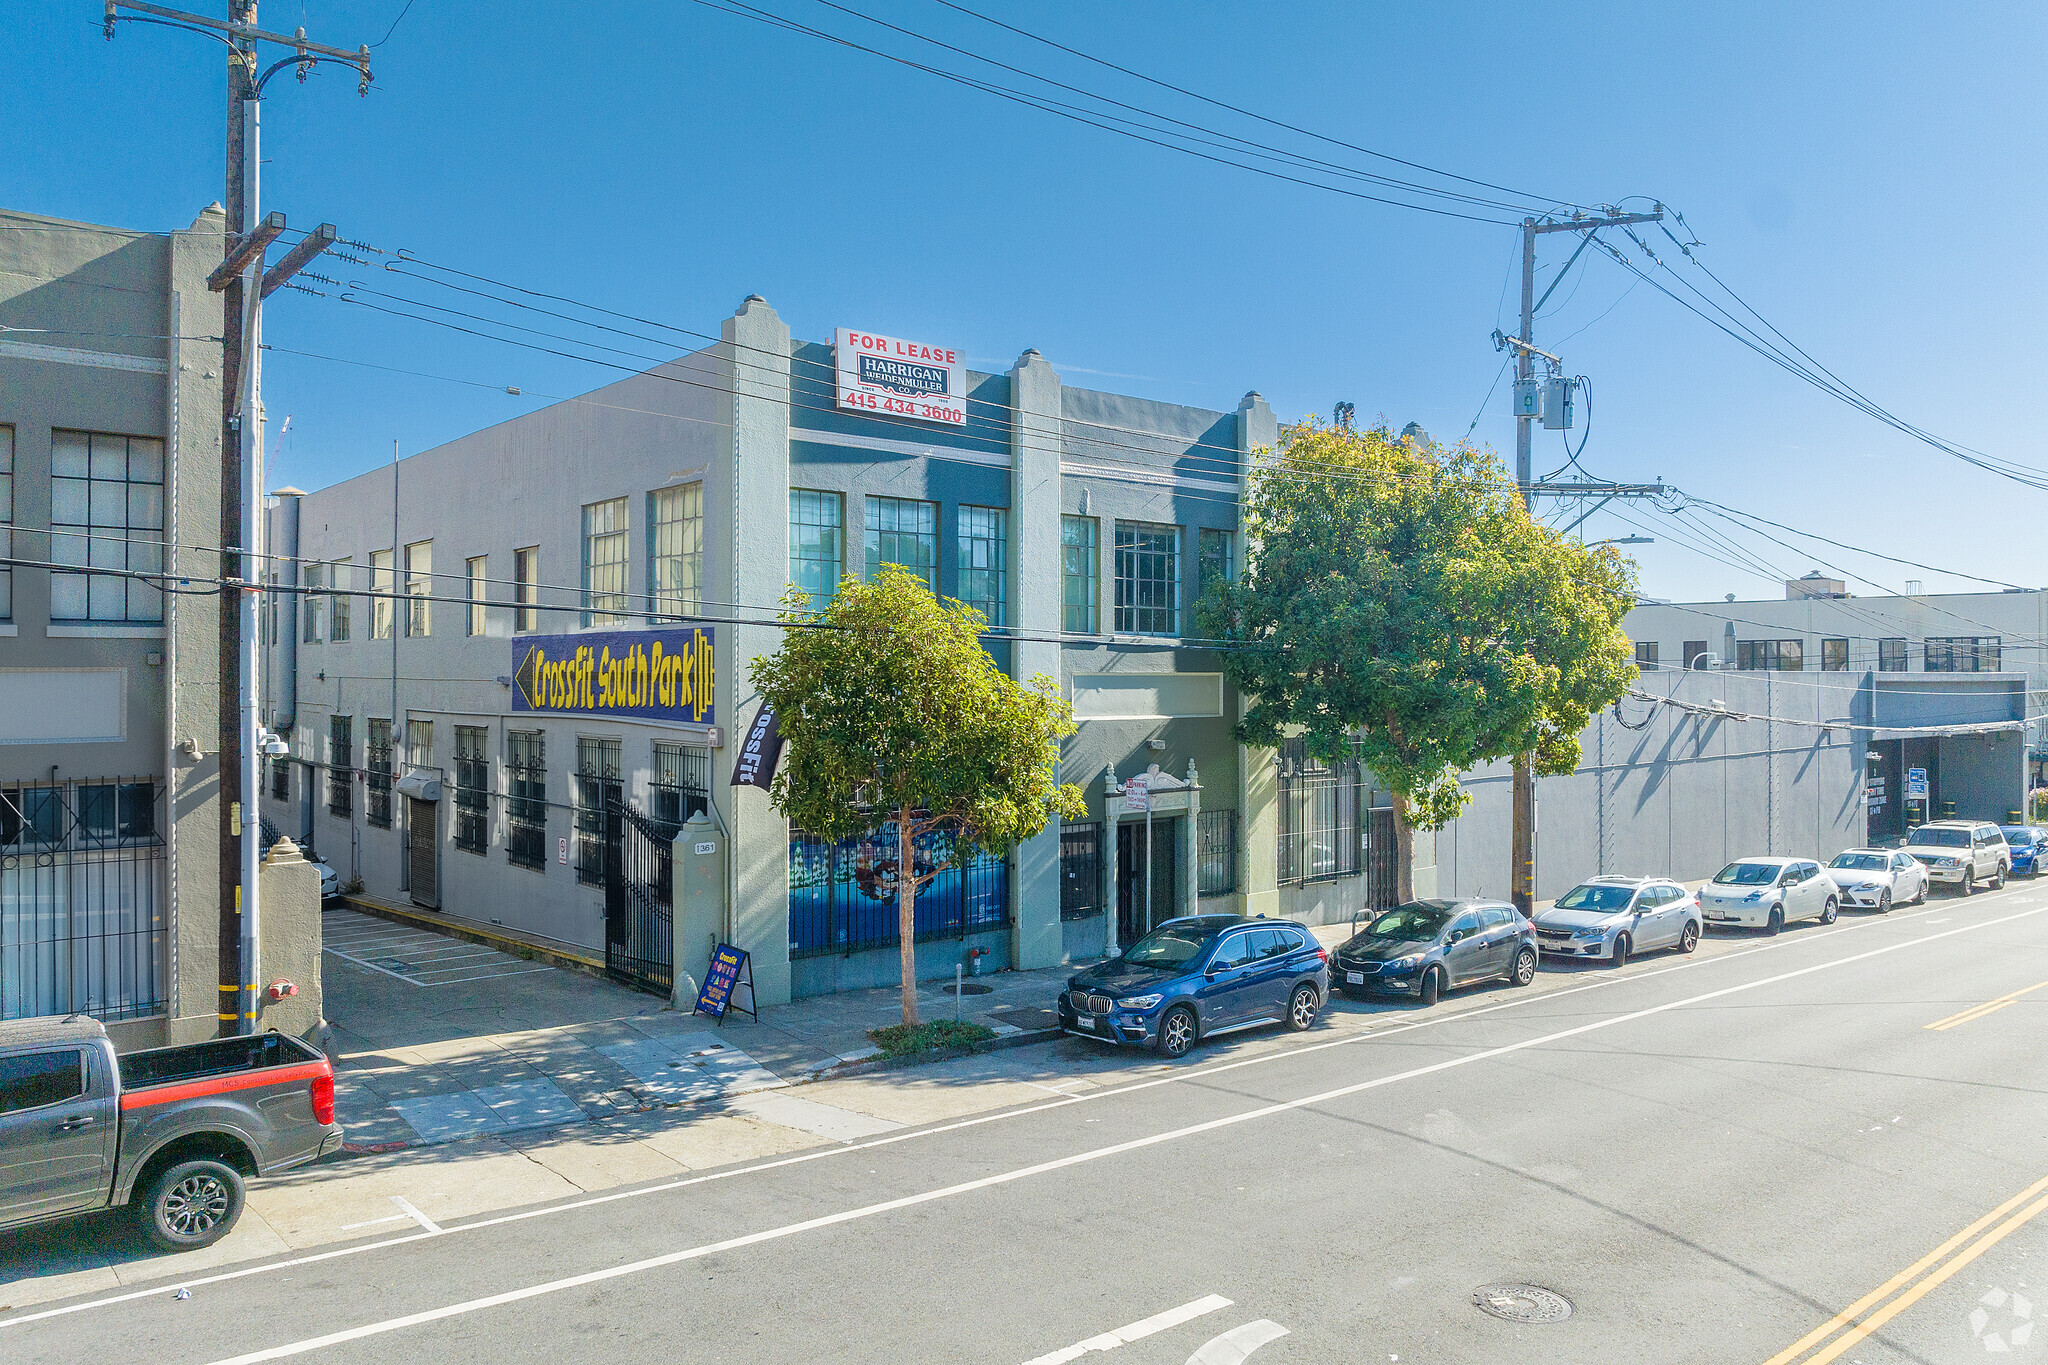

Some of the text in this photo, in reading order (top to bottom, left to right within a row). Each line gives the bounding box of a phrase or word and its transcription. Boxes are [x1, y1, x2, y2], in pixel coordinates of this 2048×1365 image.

[849, 333, 956, 364] FOR LEASE
[865, 358, 942, 382] HARRIGAN
[866, 371, 942, 392] WEIDENMULLER
[898, 387, 912, 395] CO.
[846, 392, 962, 423] 415 434 3600
[534, 640, 695, 709] CrossFit South Park
[740, 701, 776, 784] rossFit
[696, 844, 714, 853] 1361
[222, 1081, 240, 1089] MCS
